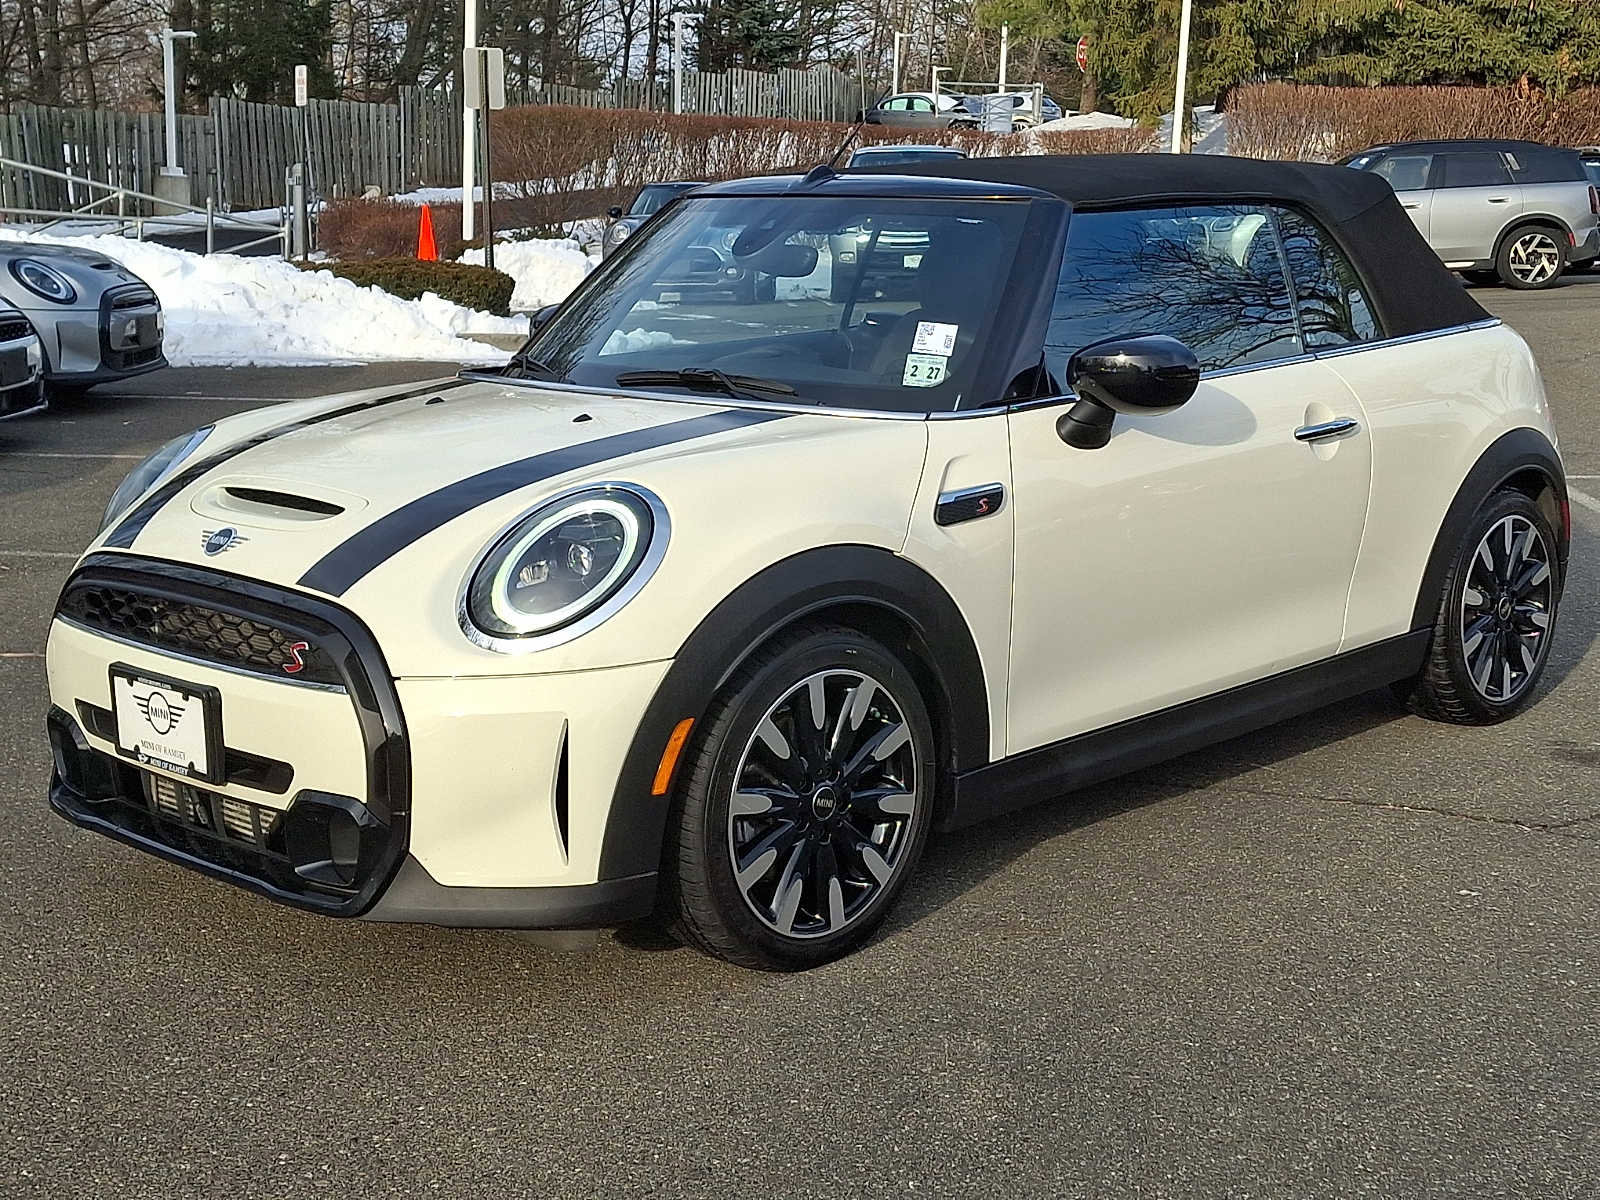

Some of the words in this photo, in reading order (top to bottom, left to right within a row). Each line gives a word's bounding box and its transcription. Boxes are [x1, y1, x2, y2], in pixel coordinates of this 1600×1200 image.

[910, 364, 919, 378] 2
[926, 366, 941, 380] 27
[282, 641, 309, 673] S
[150, 705, 169, 721] MINI
[816, 797, 834, 808] MINI
